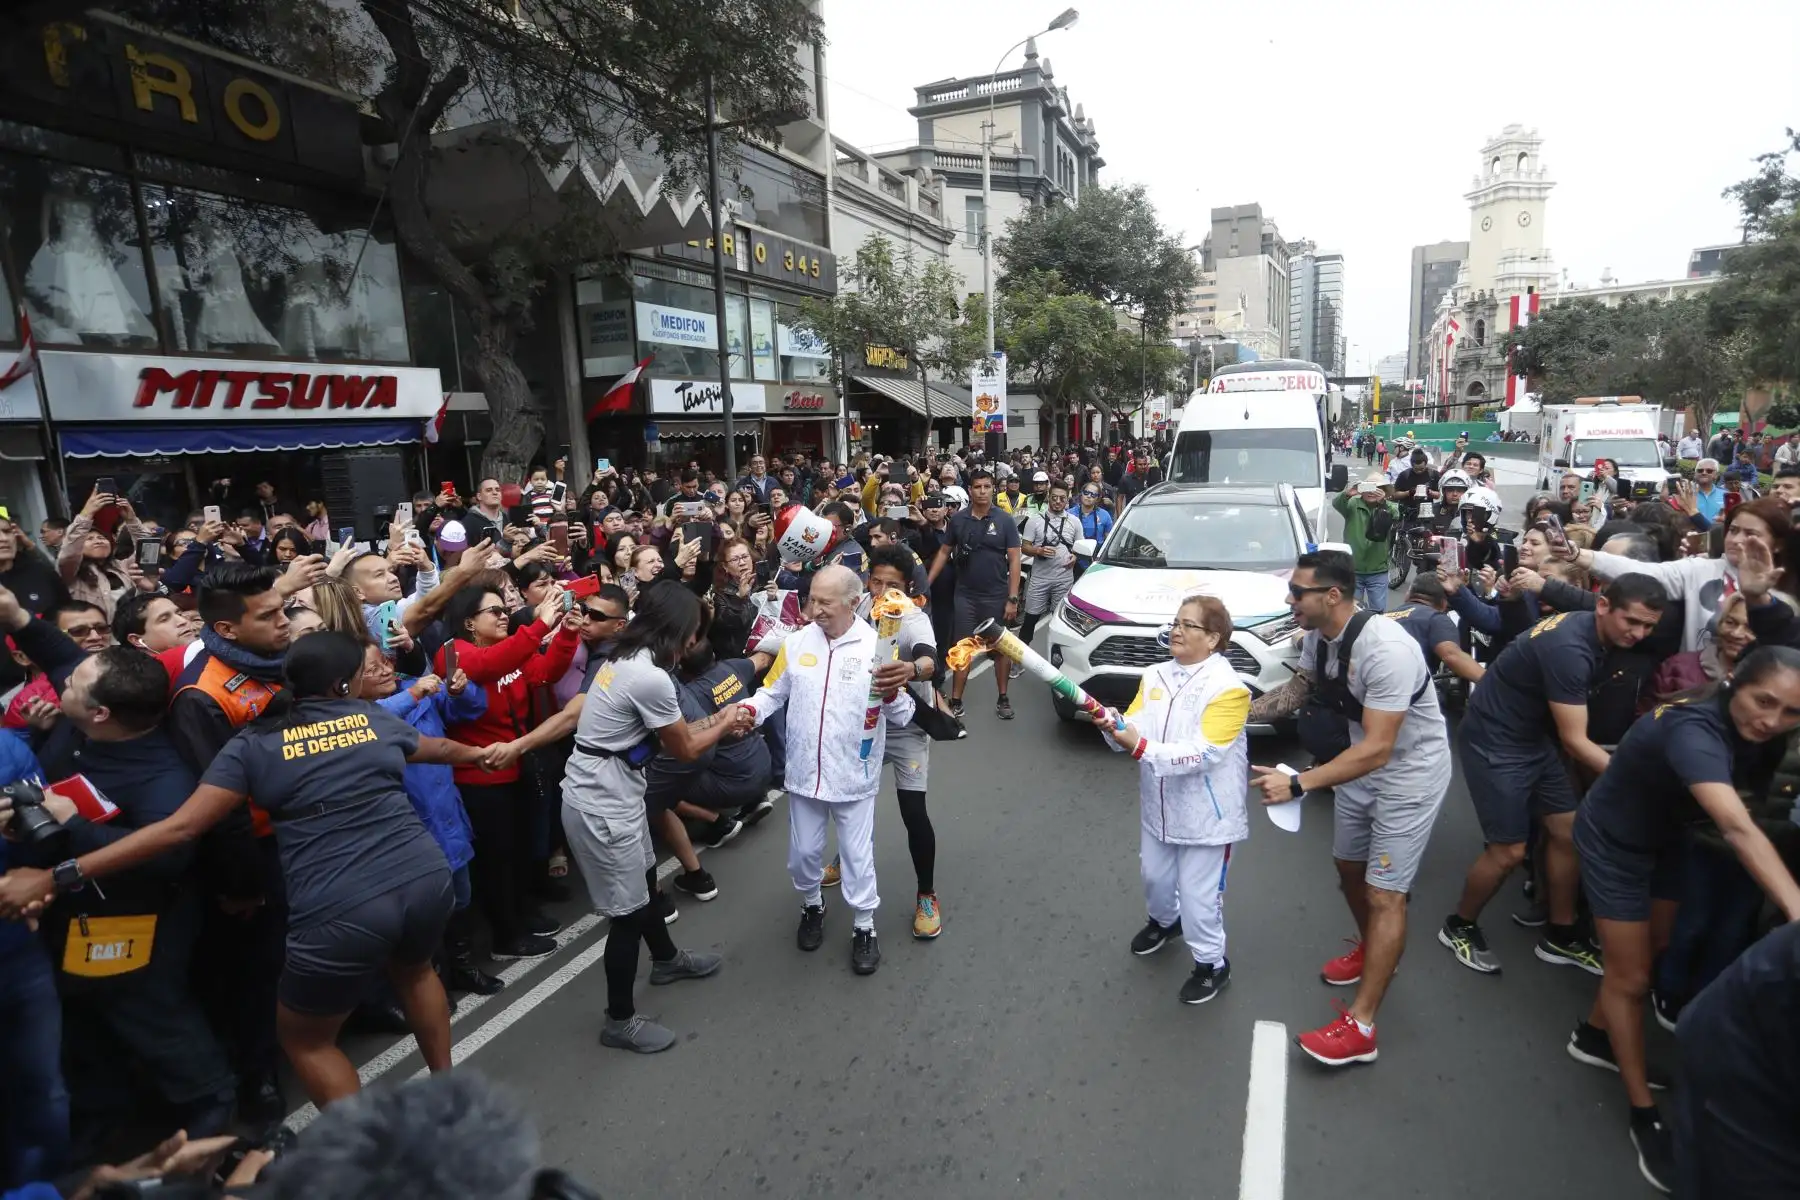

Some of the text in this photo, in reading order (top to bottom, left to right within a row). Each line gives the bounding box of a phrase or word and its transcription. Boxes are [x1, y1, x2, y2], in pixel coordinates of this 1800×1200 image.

[783, 250, 821, 278] 345
[660, 314, 706, 333] MEDIFON
[134, 367, 399, 410] MITSUWA
[786, 536, 818, 556] VAMOS
[283, 713, 369, 742] MINISTERIO
[282, 728, 378, 760] DE DEFENSA
[91, 942, 125, 960] CAT
